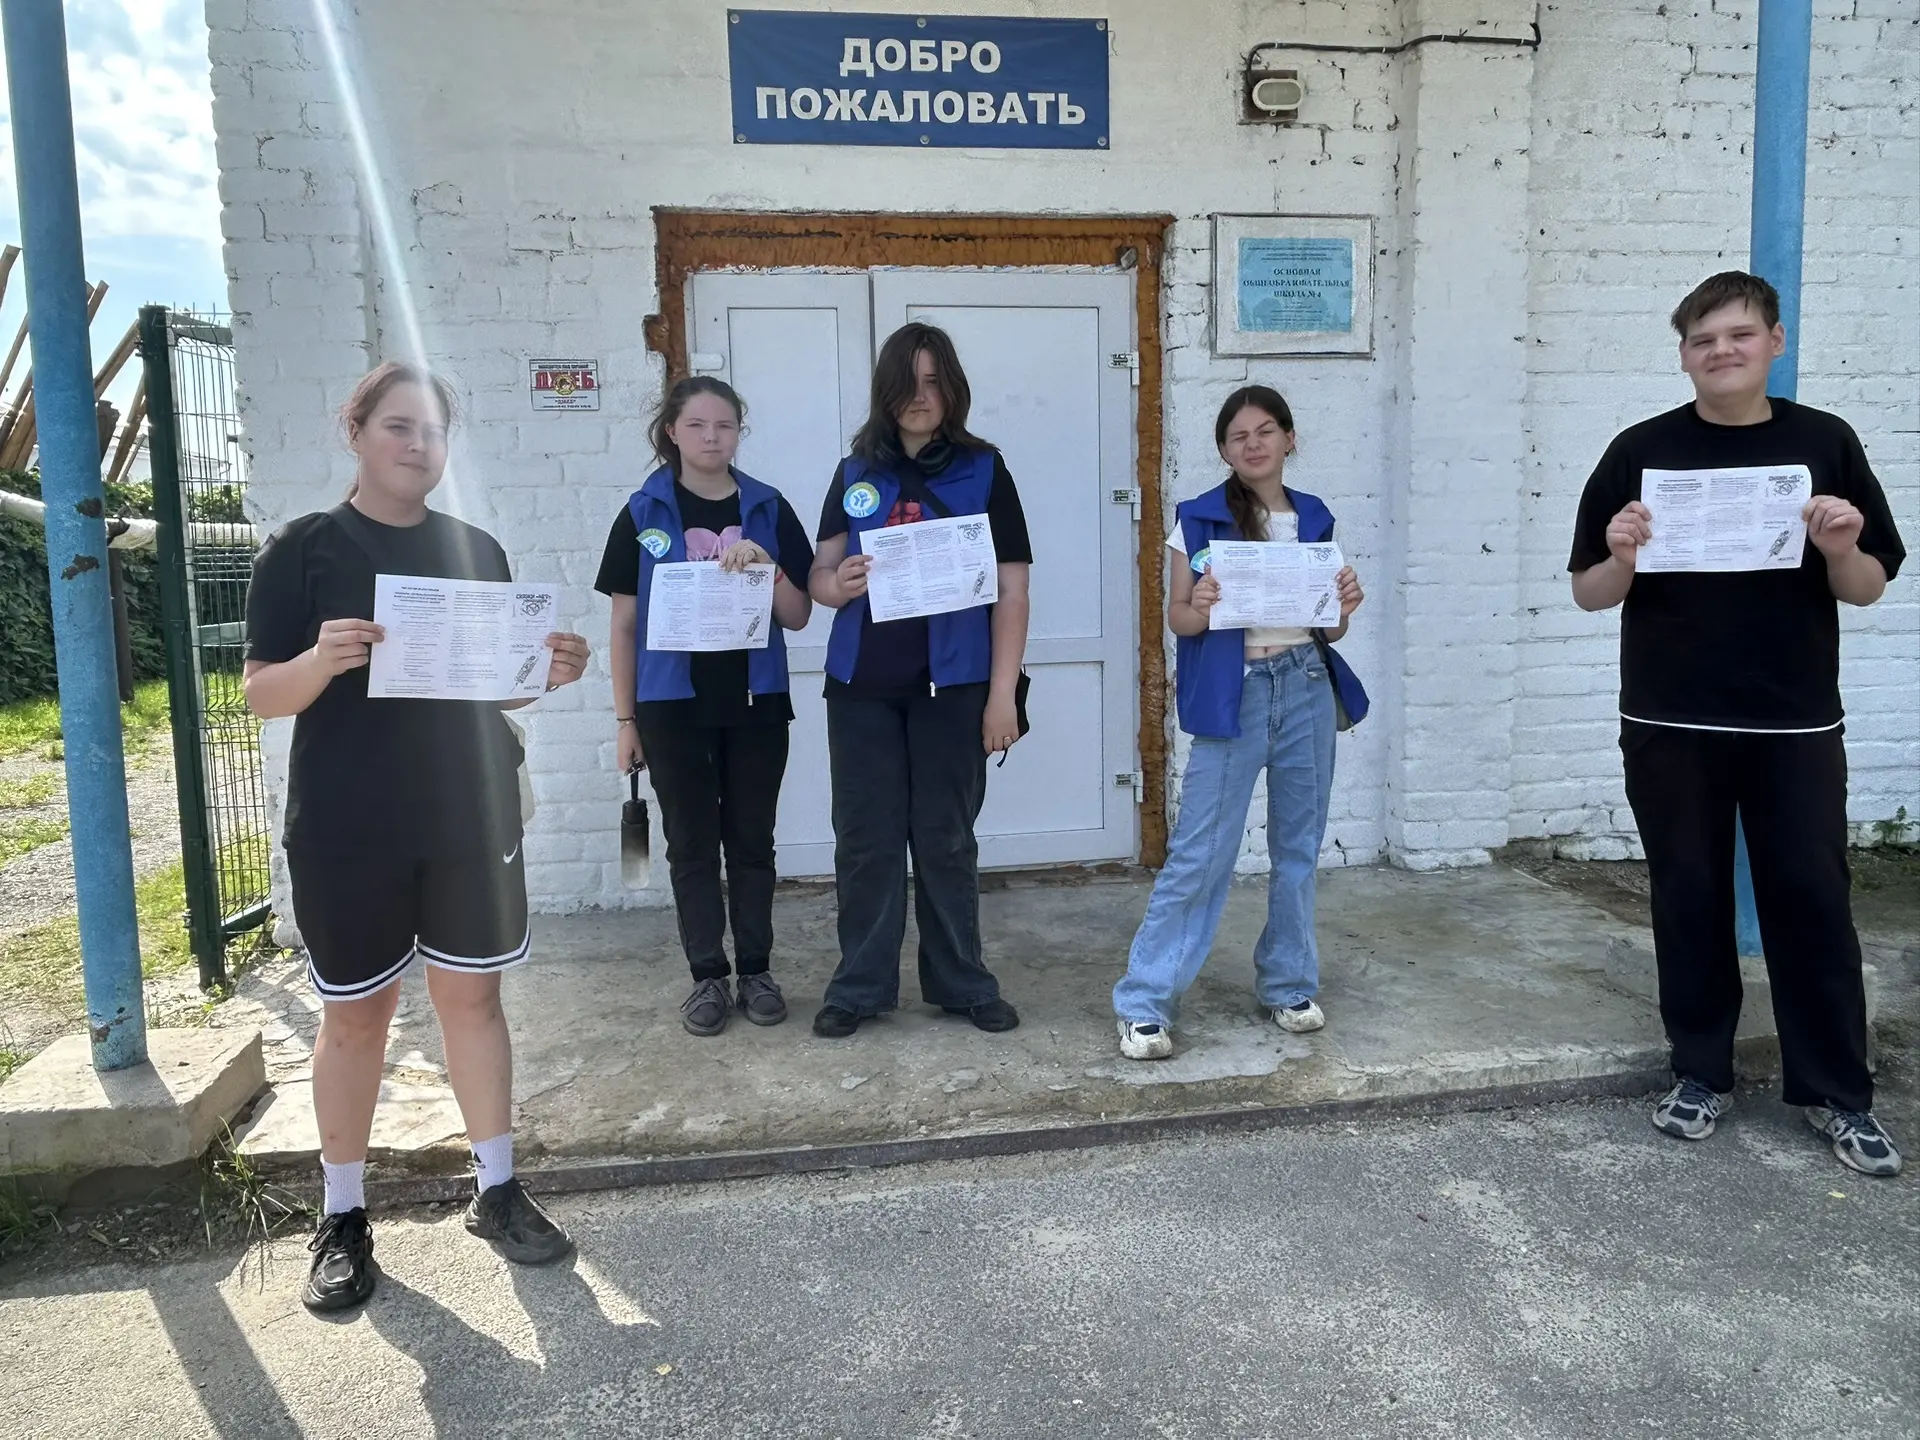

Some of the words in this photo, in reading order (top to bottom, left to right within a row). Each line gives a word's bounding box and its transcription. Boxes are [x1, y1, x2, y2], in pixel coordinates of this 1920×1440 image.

[839, 37, 1001, 77] ДОБРО
[755, 86, 1087, 125] ПОЖАЛОВАТЬ
[1273, 268, 1321, 276] ОСНОВНАЯ
[1273, 290, 1306, 298] ШКОЛА
